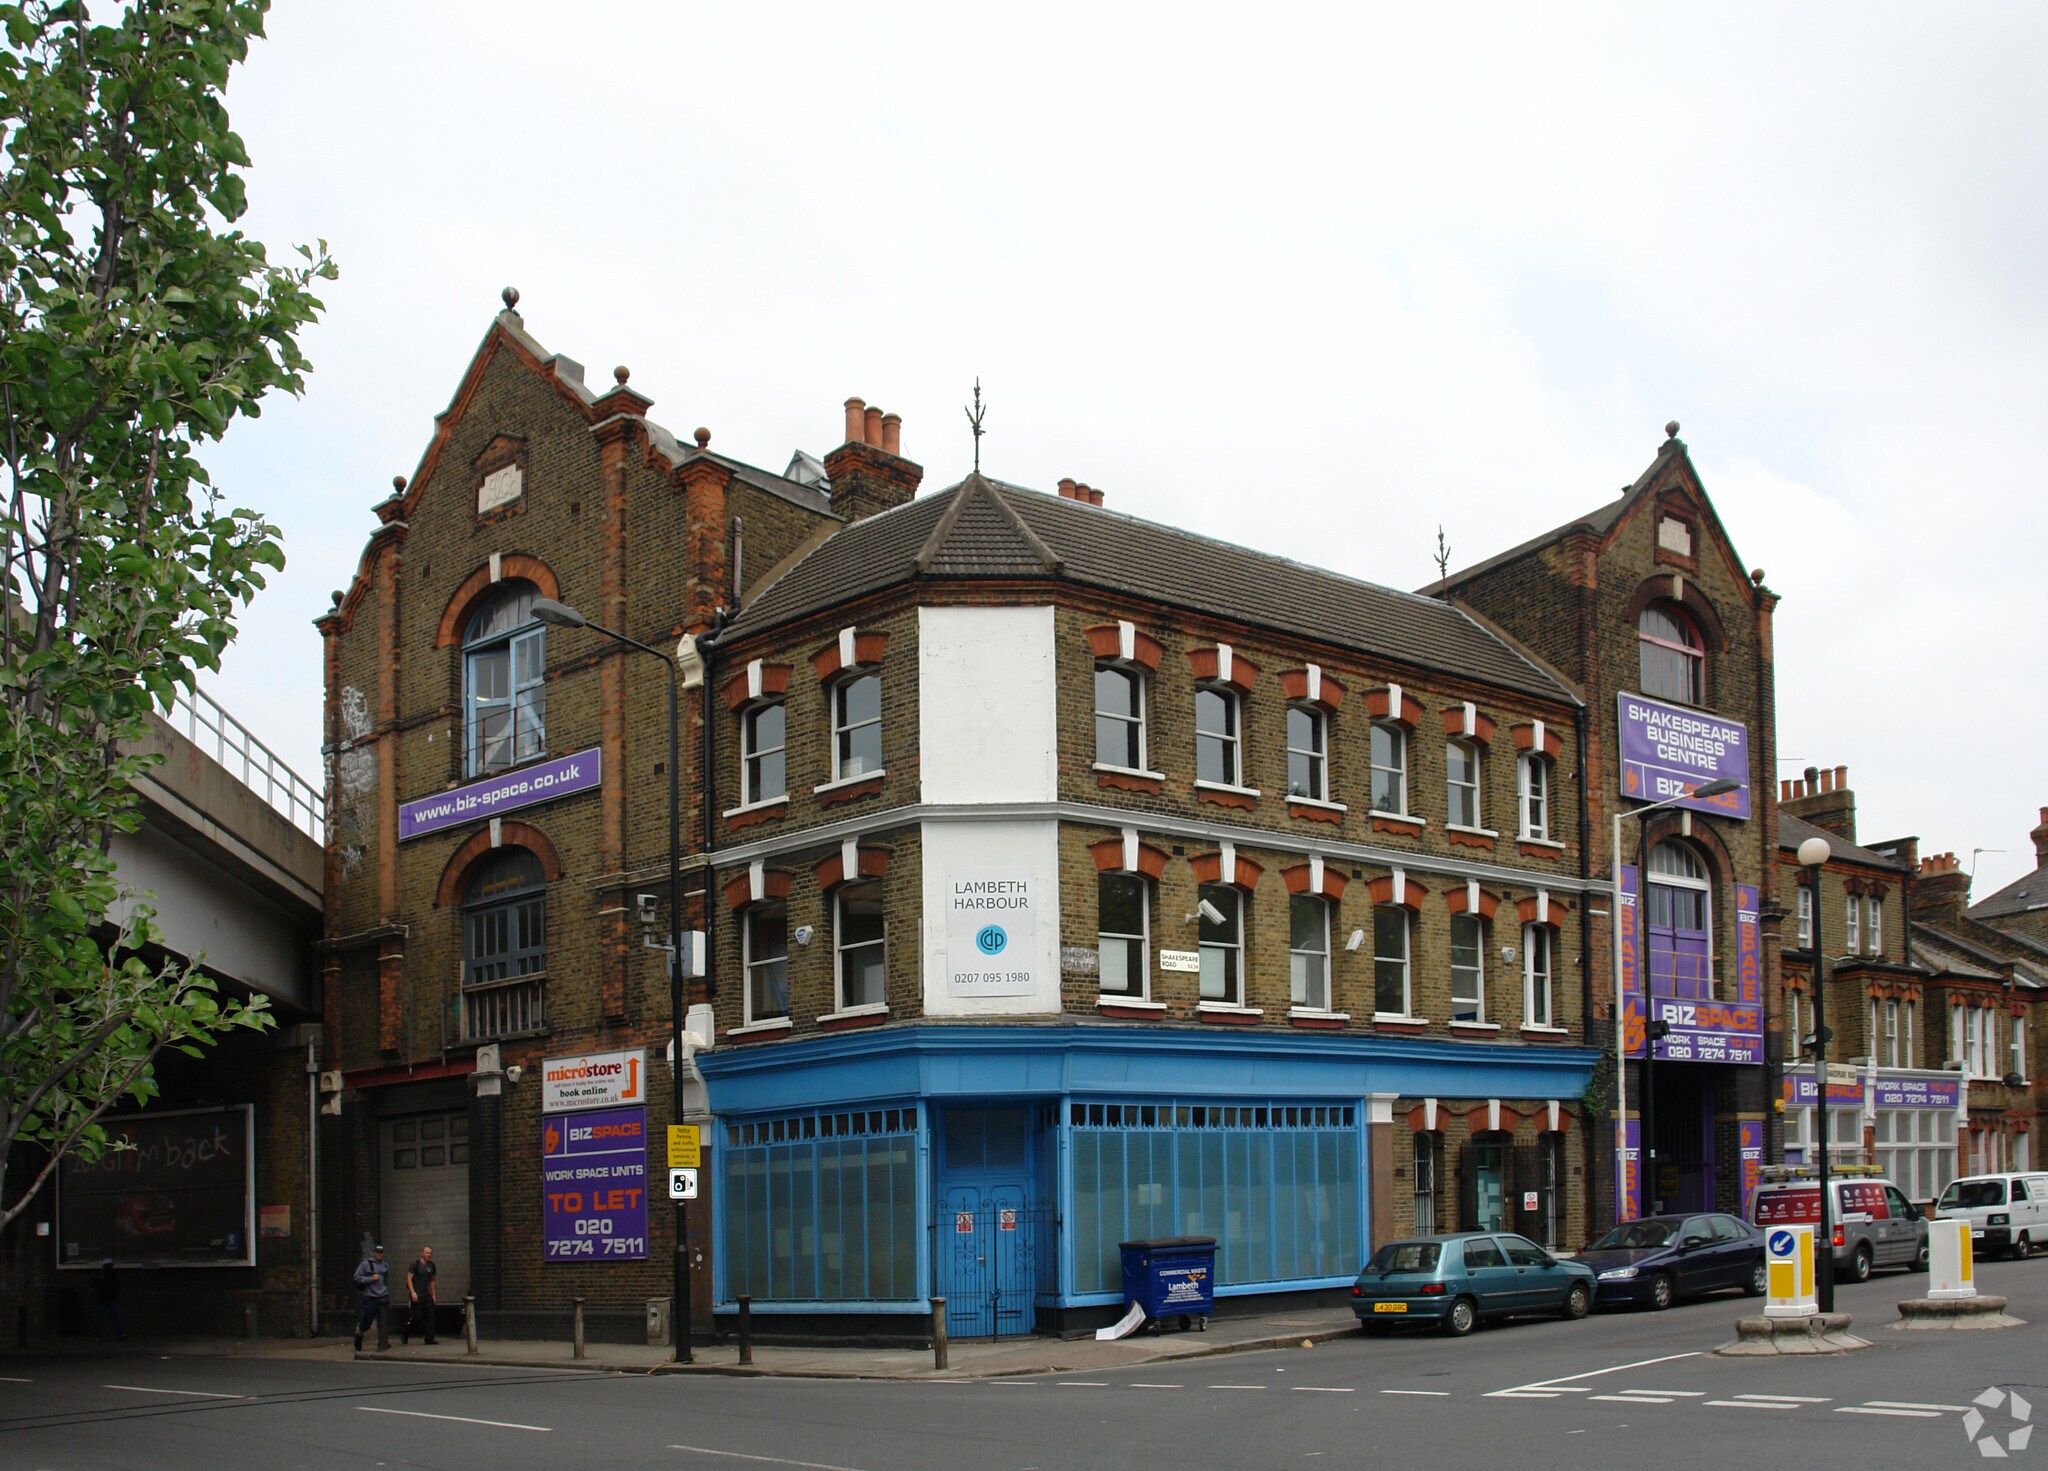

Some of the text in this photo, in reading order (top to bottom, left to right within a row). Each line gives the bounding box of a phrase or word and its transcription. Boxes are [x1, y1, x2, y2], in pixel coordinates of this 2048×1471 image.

[1628, 704, 1740, 745] SHAKESPEARE
[1647, 725, 1725, 756] BUSINESS
[1657, 744, 1718, 770] CENTRE
[415, 764, 580, 823] www.biz-space.co.uk
[1656, 777, 1739, 809] BIZSCE
[955, 881, 1027, 894] LAMBETH
[954, 897, 1029, 909] HARBOUR
[1739, 913, 1757, 923] BIZ
[1161, 953, 1198, 963] SHAKESPEARE
[1741, 923, 1757, 1001] SPACE
[954, 972, 1030, 983] 0207 095 1980
[1662, 1004, 1758, 1030] BIZSPACE
[1664, 1034, 1759, 1048] WORK SPACE TO LET
[1668, 1046, 1752, 1061] 020 7274 7511
[547, 1059, 622, 1081] microstore
[560, 1086, 608, 1097] book online
[1877, 1081, 1956, 1093] WORK SPACE TO LET
[549, 1093, 620, 1107] www.microstore.co.uk
[1885, 1093, 1949, 1104] 020 7274 7511
[570, 1123, 642, 1142] BIZSPACE
[165, 1126, 231, 1169] back
[1743, 1151, 1760, 1160] BIZ
[545, 1164, 644, 1181] WORK SPACE UNITS
[548, 1189, 642, 1213] TO LET
[575, 1219, 613, 1235] 020
[549, 1237, 644, 1256] 7274 7511
[1168, 1281, 1199, 1291] Lambeth
